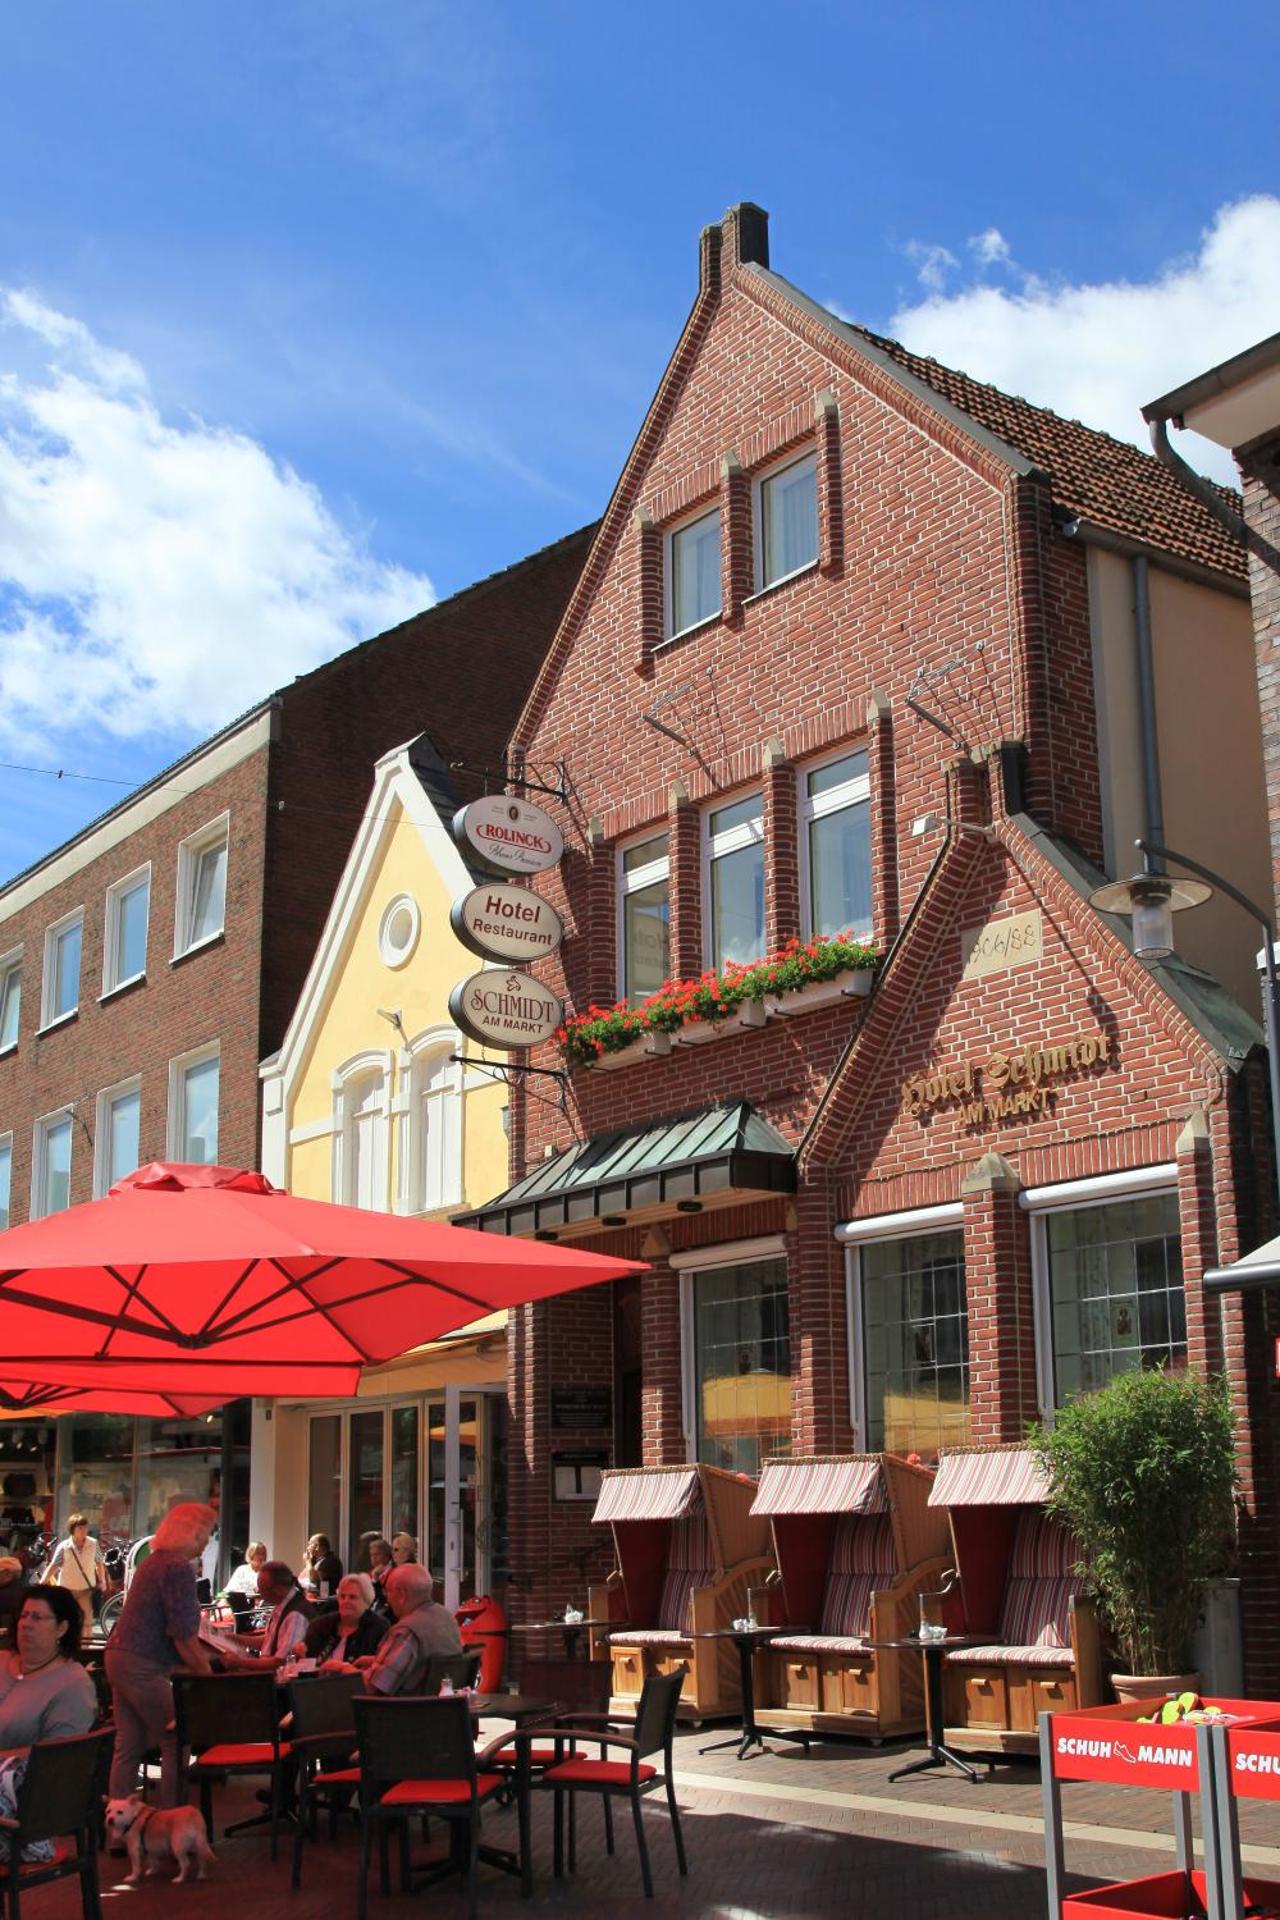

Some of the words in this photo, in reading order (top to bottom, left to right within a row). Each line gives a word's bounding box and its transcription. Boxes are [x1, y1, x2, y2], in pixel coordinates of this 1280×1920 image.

[486, 823, 544, 850] ROLINCK
[485, 895, 541, 923] Hotel
[473, 918, 552, 946] Restaurant
[470, 988, 554, 1023] SCHMIDT
[482, 1015, 500, 1027] AM
[503, 1018, 544, 1034] MARKT
[902, 1061, 974, 1117] Hotel
[986, 1031, 1112, 1088] Schmidt
[957, 1100, 984, 1126] AM
[988, 1087, 1049, 1119] MARKT
[1057, 1737, 1112, 1759] SCHUH
[1137, 1745, 1193, 1767] MANN
